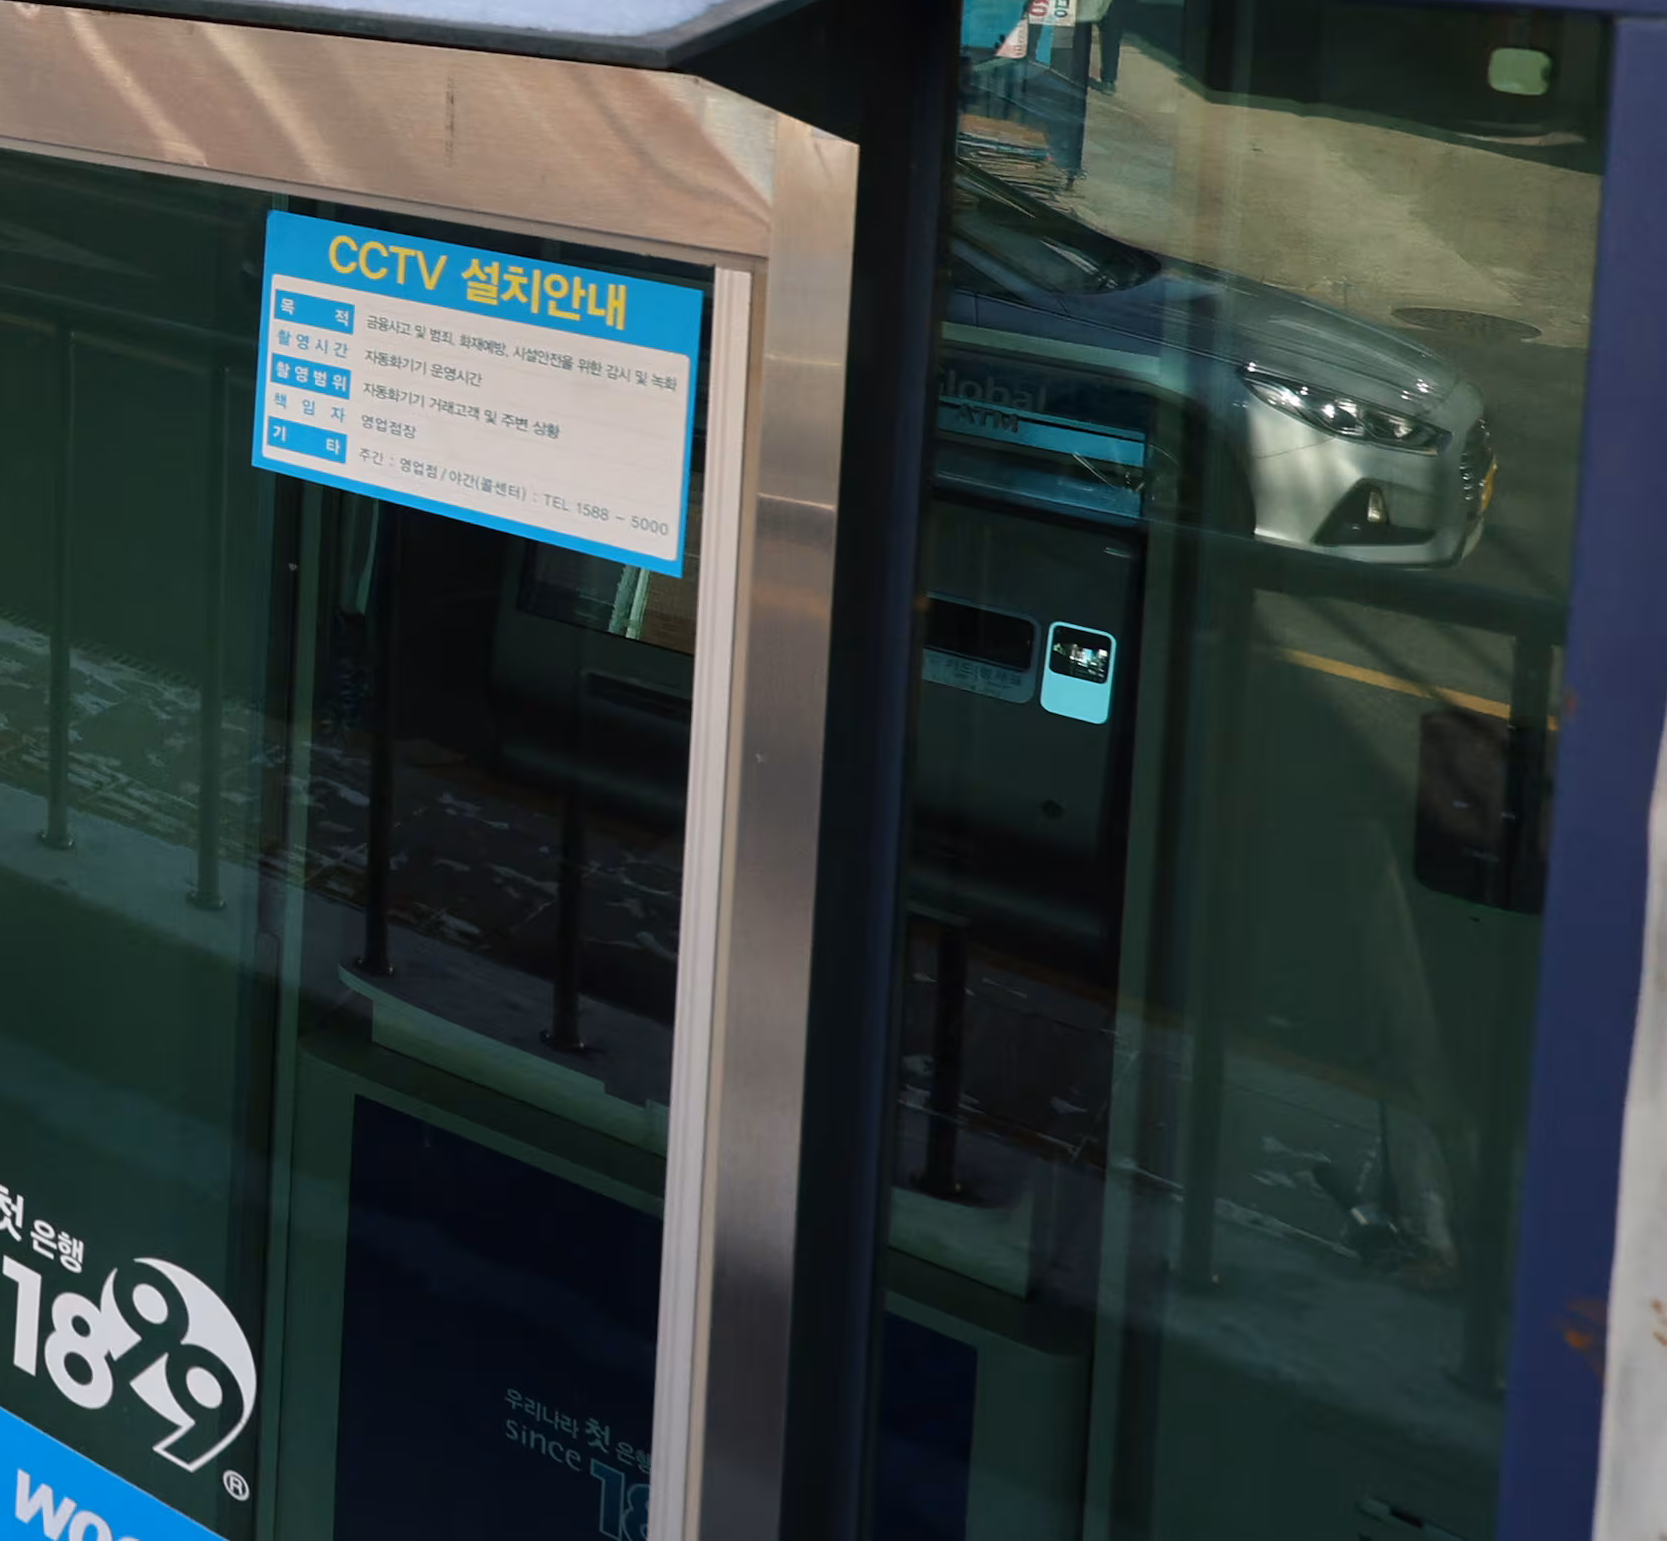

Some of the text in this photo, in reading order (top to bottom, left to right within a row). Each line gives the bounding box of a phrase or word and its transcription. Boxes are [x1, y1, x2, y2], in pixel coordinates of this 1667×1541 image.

[328, 235, 627, 330] CCTV 설치안내
[364, 350, 427, 376] 자동화기기
[430, 364, 482, 388] 운영시간
[366, 315, 411, 336] 금융사고
[578, 359, 602, 377] 위한
[606, 365, 631, 382] 감시
[275, 361, 560, 440] 촬영범위 자동화기기 거래고객 및 주변 상황
[940, 368, 1047, 412] lobal
[360, 414, 417, 439] 영업점장
[359, 448, 384, 466] 주간
[400, 457, 438, 479] 영업점
[543, 493, 570, 512] TEL
[576, 502, 610, 521] 1588
[631, 514, 669, 536] 5000
[30, 1219, 85, 1274] 은행
[505, 1388, 581, 1439] 우리나라
[584, 1417, 611, 1454] 첫
